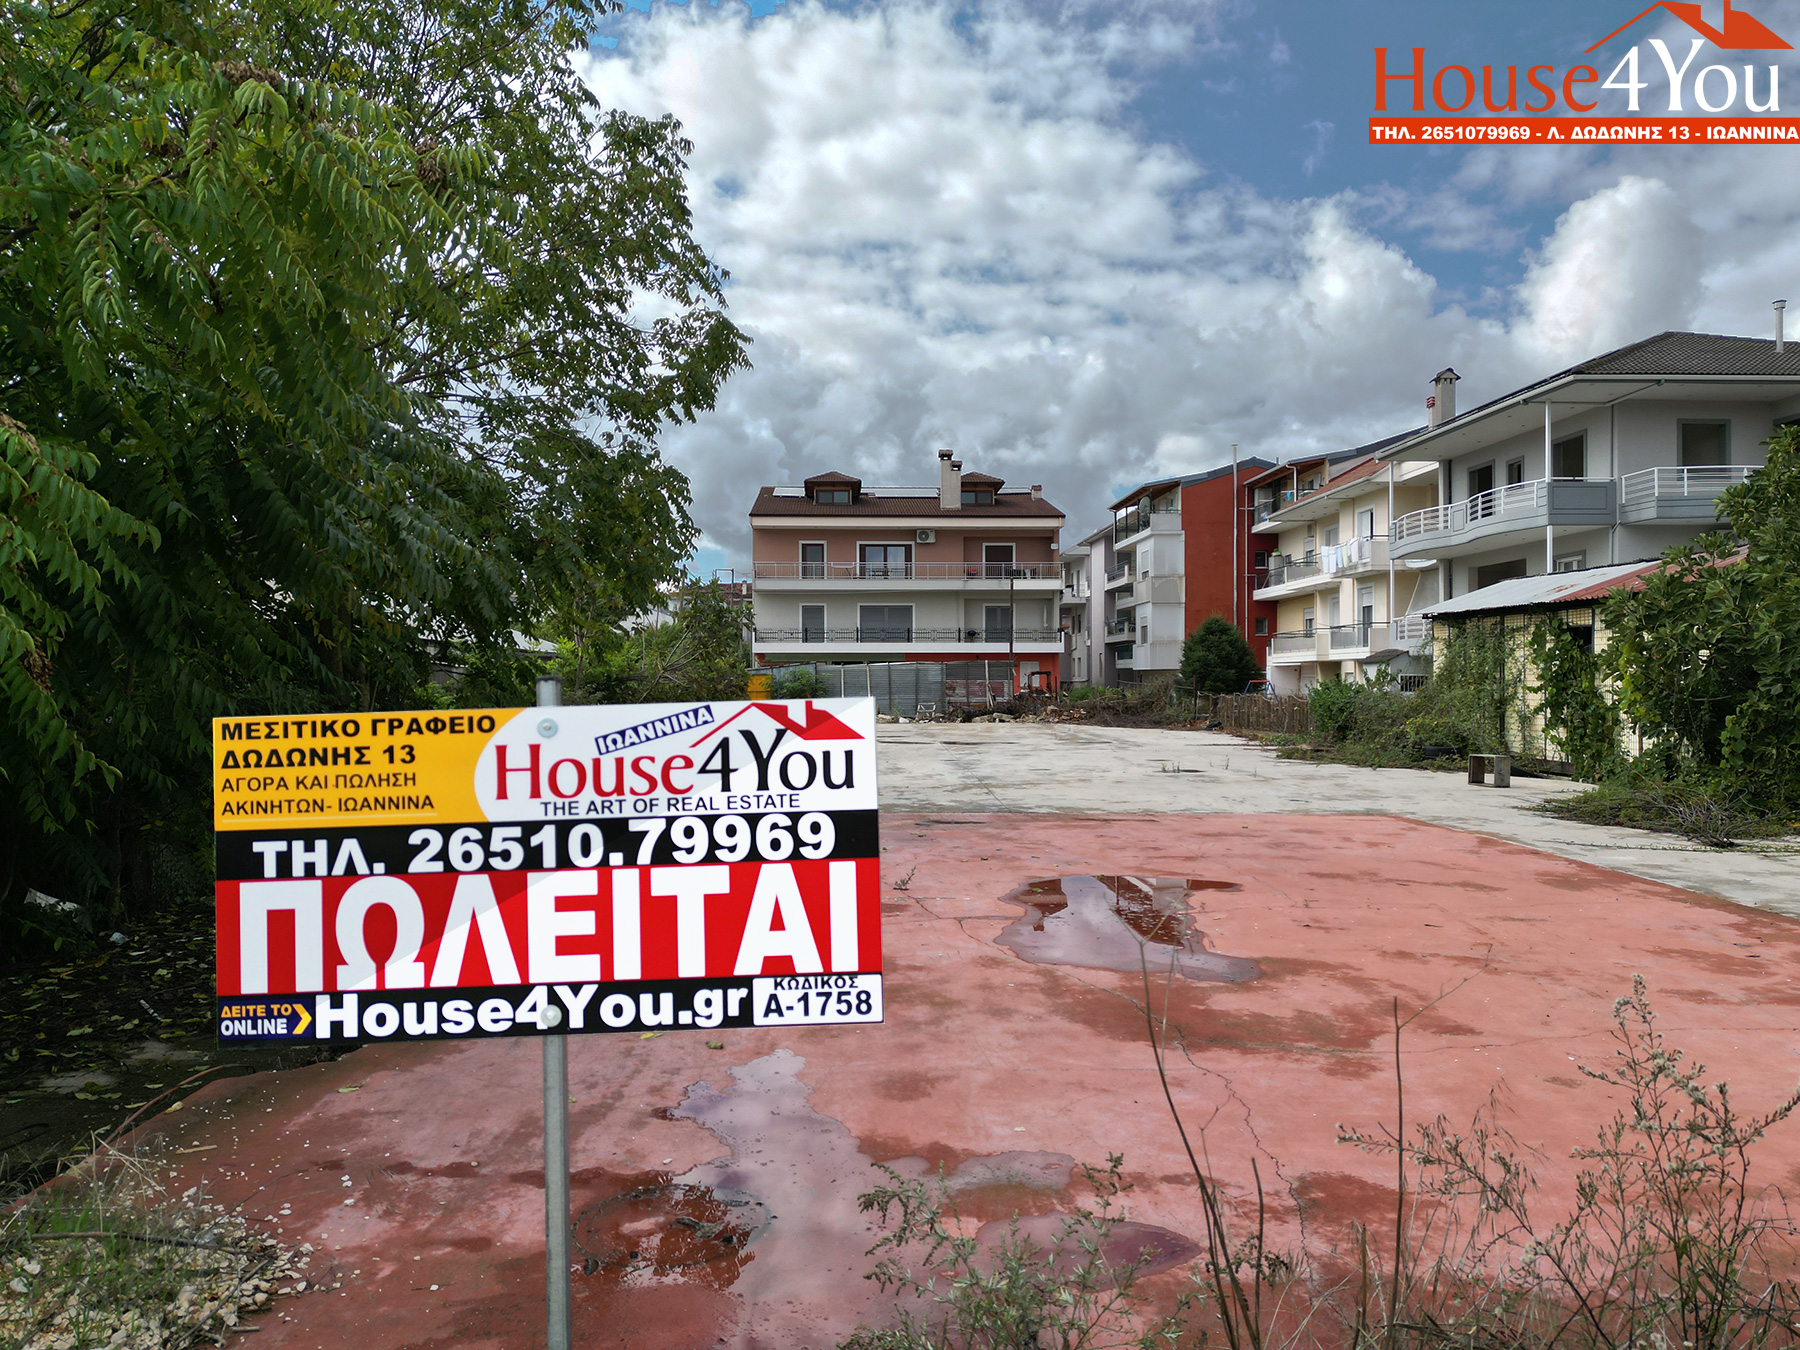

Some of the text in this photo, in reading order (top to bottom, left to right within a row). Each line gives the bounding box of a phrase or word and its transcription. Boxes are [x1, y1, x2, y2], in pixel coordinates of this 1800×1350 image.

[221, 715, 496, 741] ΜΕΣΙΤΙΚΟ ΓΡΑΦΕΙΟ
[597, 706, 715, 754] ΙΩΑΝΝΙΝΑ
[221, 744, 416, 769] ΔΩΔΩΝΗΣ 13
[495, 728, 855, 800] House4You
[221, 772, 416, 792] ΑΓΟΡΑ ΚΑΙ ΠΩΛΗΣΗ
[338, 795, 434, 812] ΙΩΑΝΝΙΝΑ
[540, 793, 801, 817] THE ART OF REAL ESTATE
[252, 812, 835, 878] ΤΗΛ. 26510.79969
[239, 861, 859, 994] ΠΩΛΕΙΤΑΙ
[773, 975, 858, 991] ΚΩΔΙΚΟΣ
[221, 1003, 292, 1018] ΔΕΙΤΕ ΤΟ
[315, 983, 749, 1039] House4You.gr
[763, 990, 873, 1018] Α-1758
[221, 1018, 287, 1036] ONLINE
